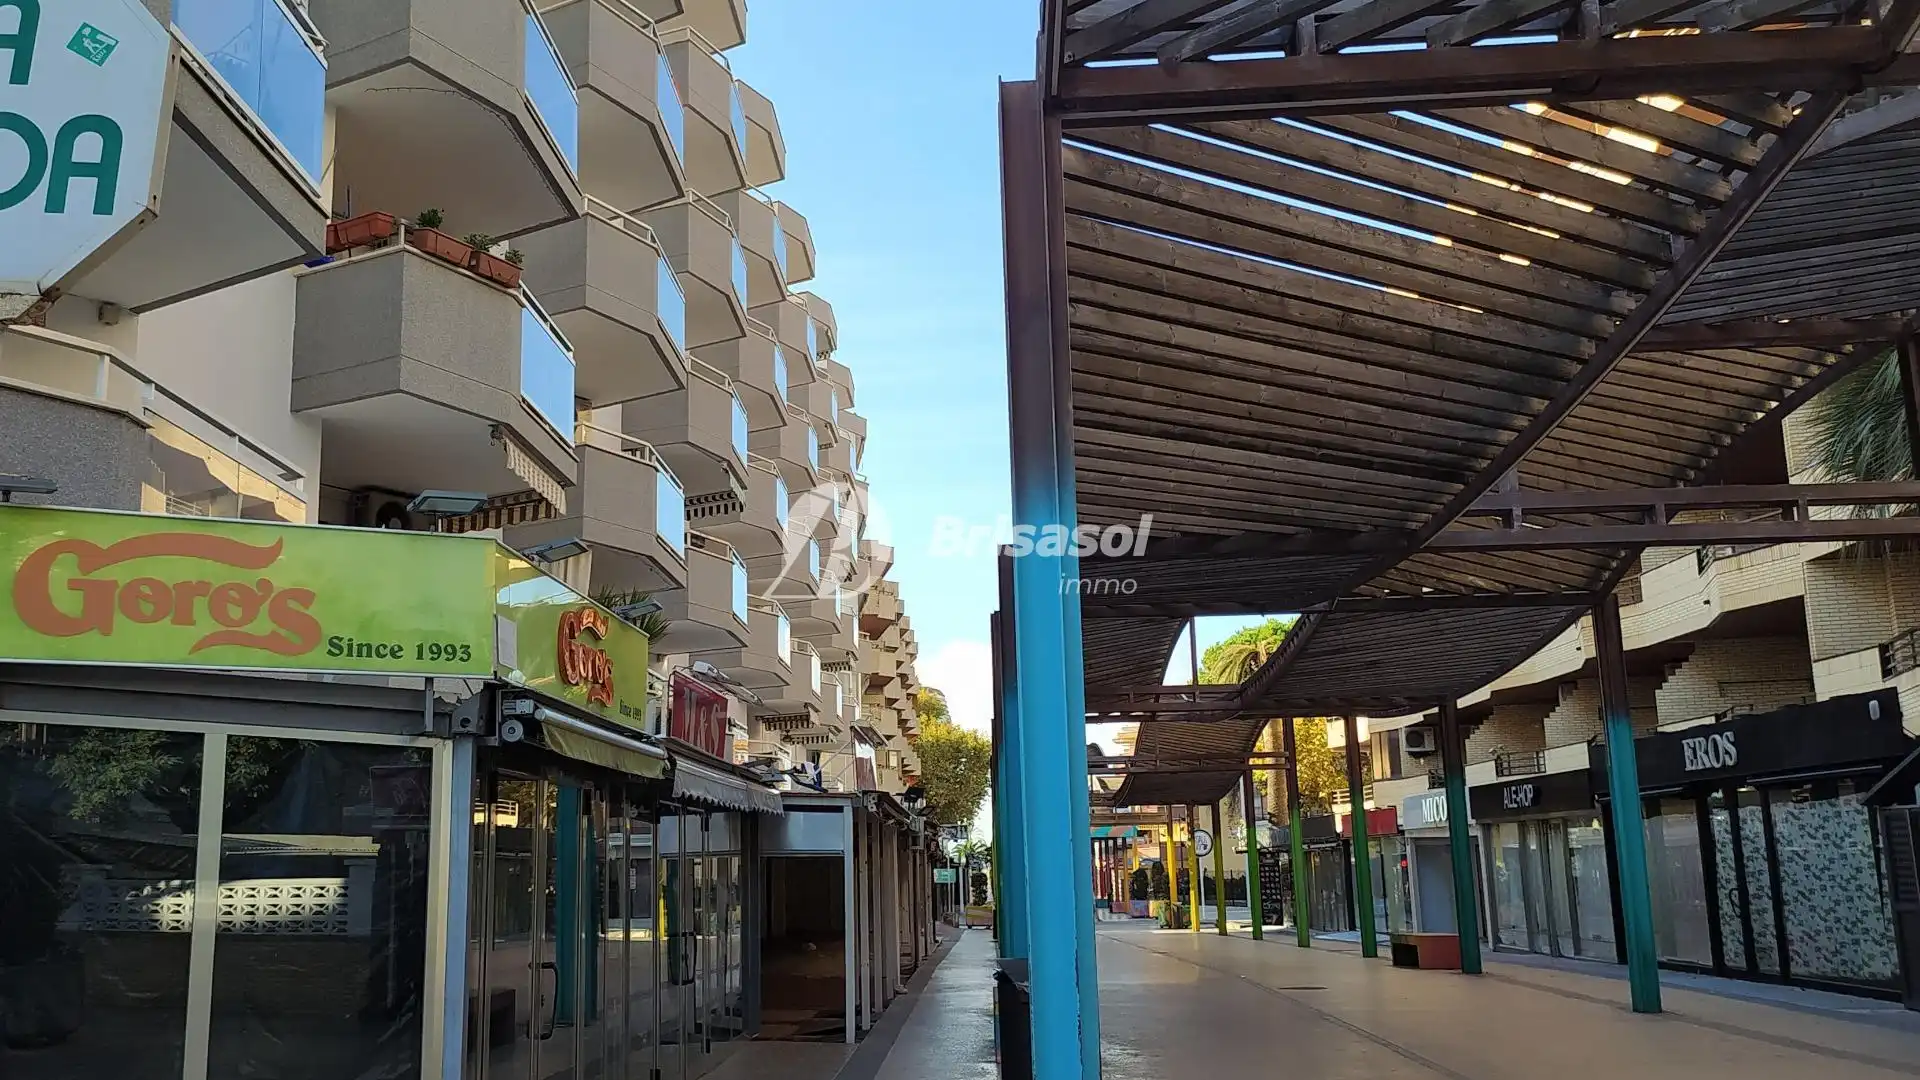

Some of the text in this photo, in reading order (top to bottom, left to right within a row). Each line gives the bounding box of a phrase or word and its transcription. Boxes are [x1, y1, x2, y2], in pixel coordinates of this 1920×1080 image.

[13, 532, 322, 657] Goro's
[326, 635, 472, 662] Since 1993
[1682, 731, 1737, 771] EROS
[1503, 784, 1533, 809] ALE-HOP
